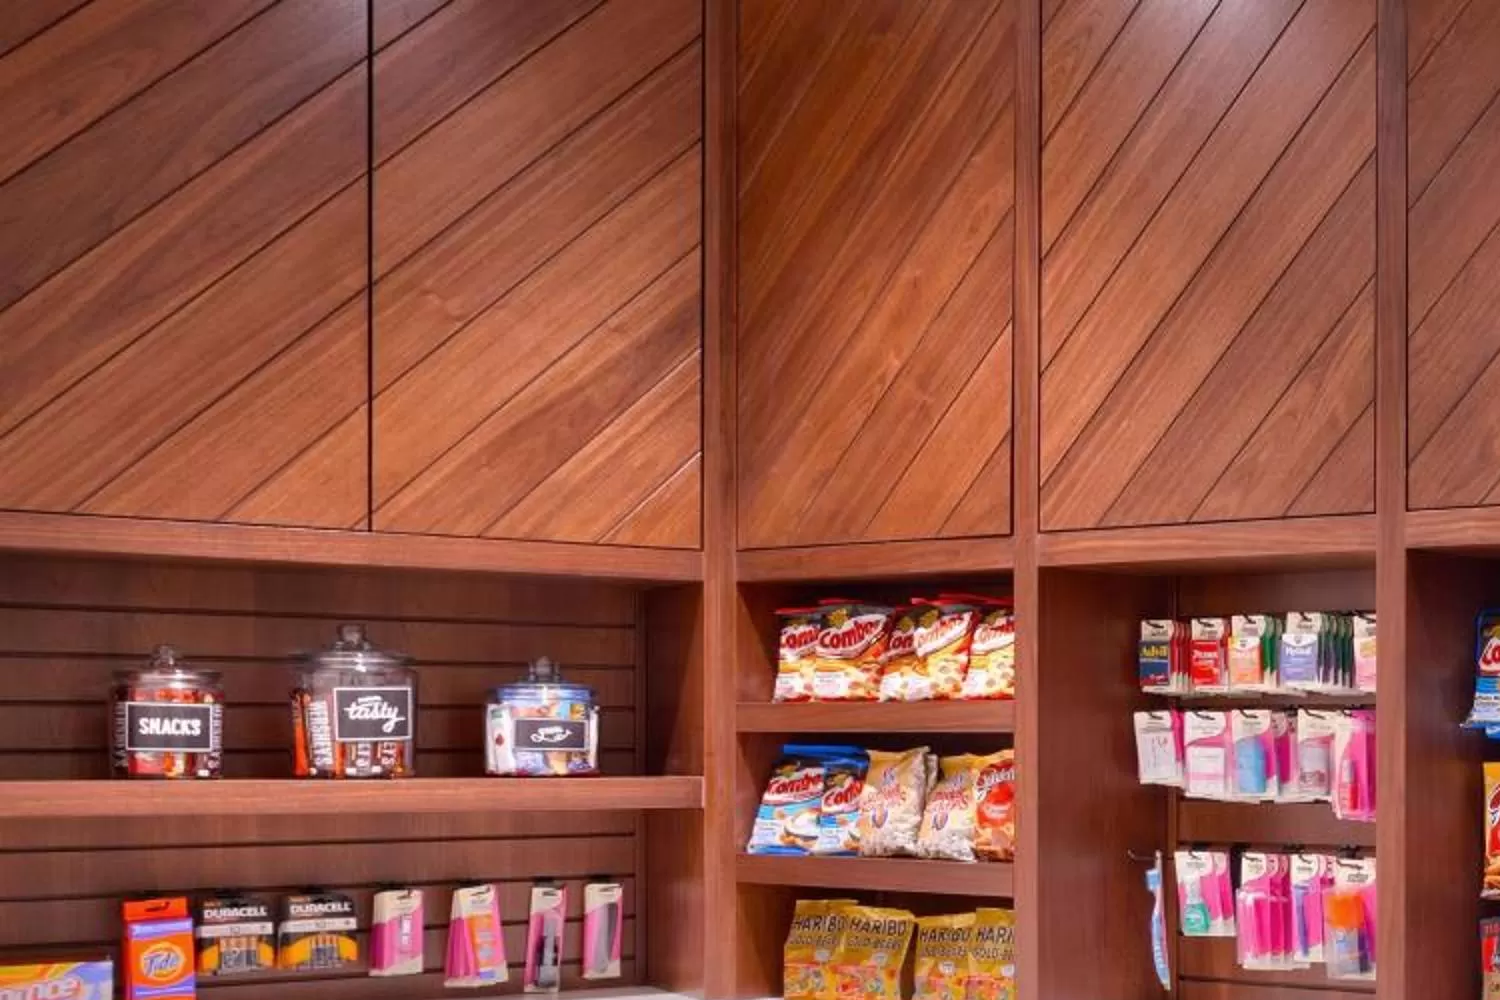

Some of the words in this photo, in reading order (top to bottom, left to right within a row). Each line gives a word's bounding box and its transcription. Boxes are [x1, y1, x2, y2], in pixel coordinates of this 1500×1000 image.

[343, 696, 405, 733] tasty
[138, 717, 202, 735] SNACKS
[204, 906, 268, 919] DURACELL
[290, 902, 352, 915] DURACELL
[850, 916, 907, 937] HARIBO
[143, 950, 182, 978] Tide
